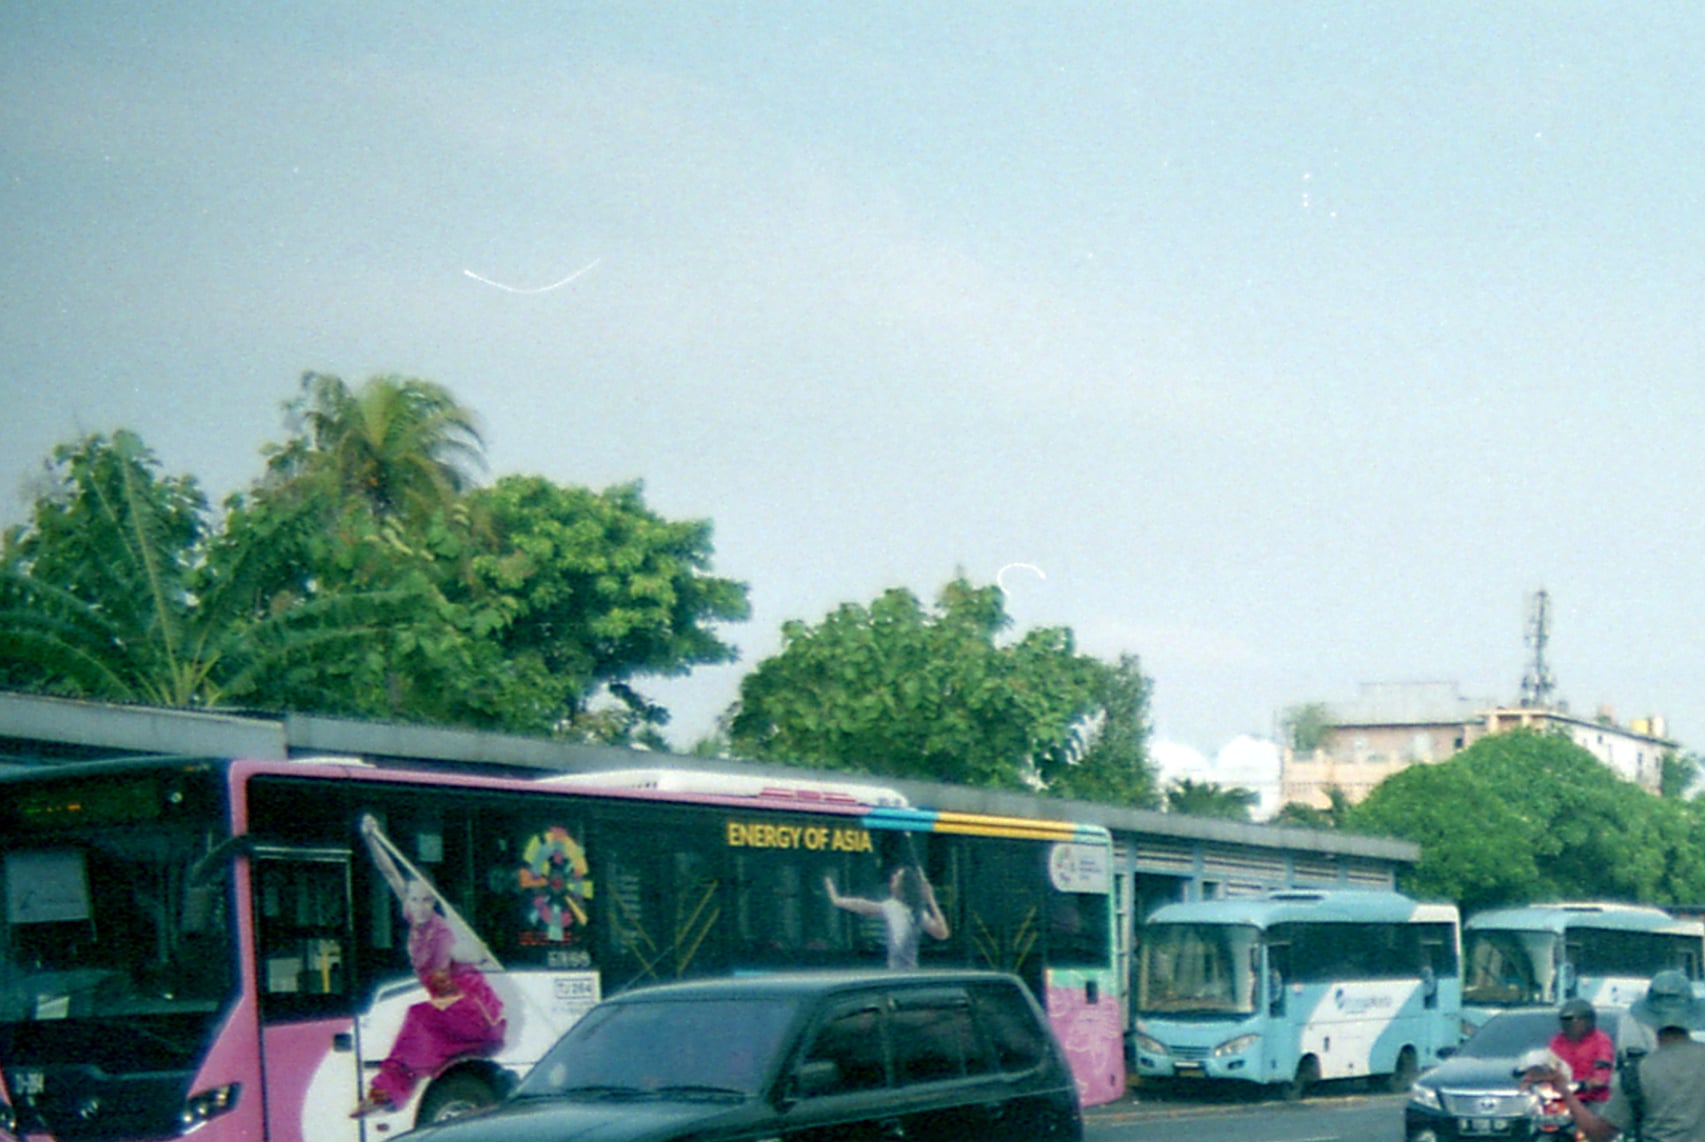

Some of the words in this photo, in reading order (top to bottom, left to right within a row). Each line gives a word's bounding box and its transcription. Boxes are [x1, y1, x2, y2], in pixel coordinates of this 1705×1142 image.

[728, 822, 802, 850] ENERGY
[803, 826, 830, 850] OF
[831, 829, 874, 853] ASIA
